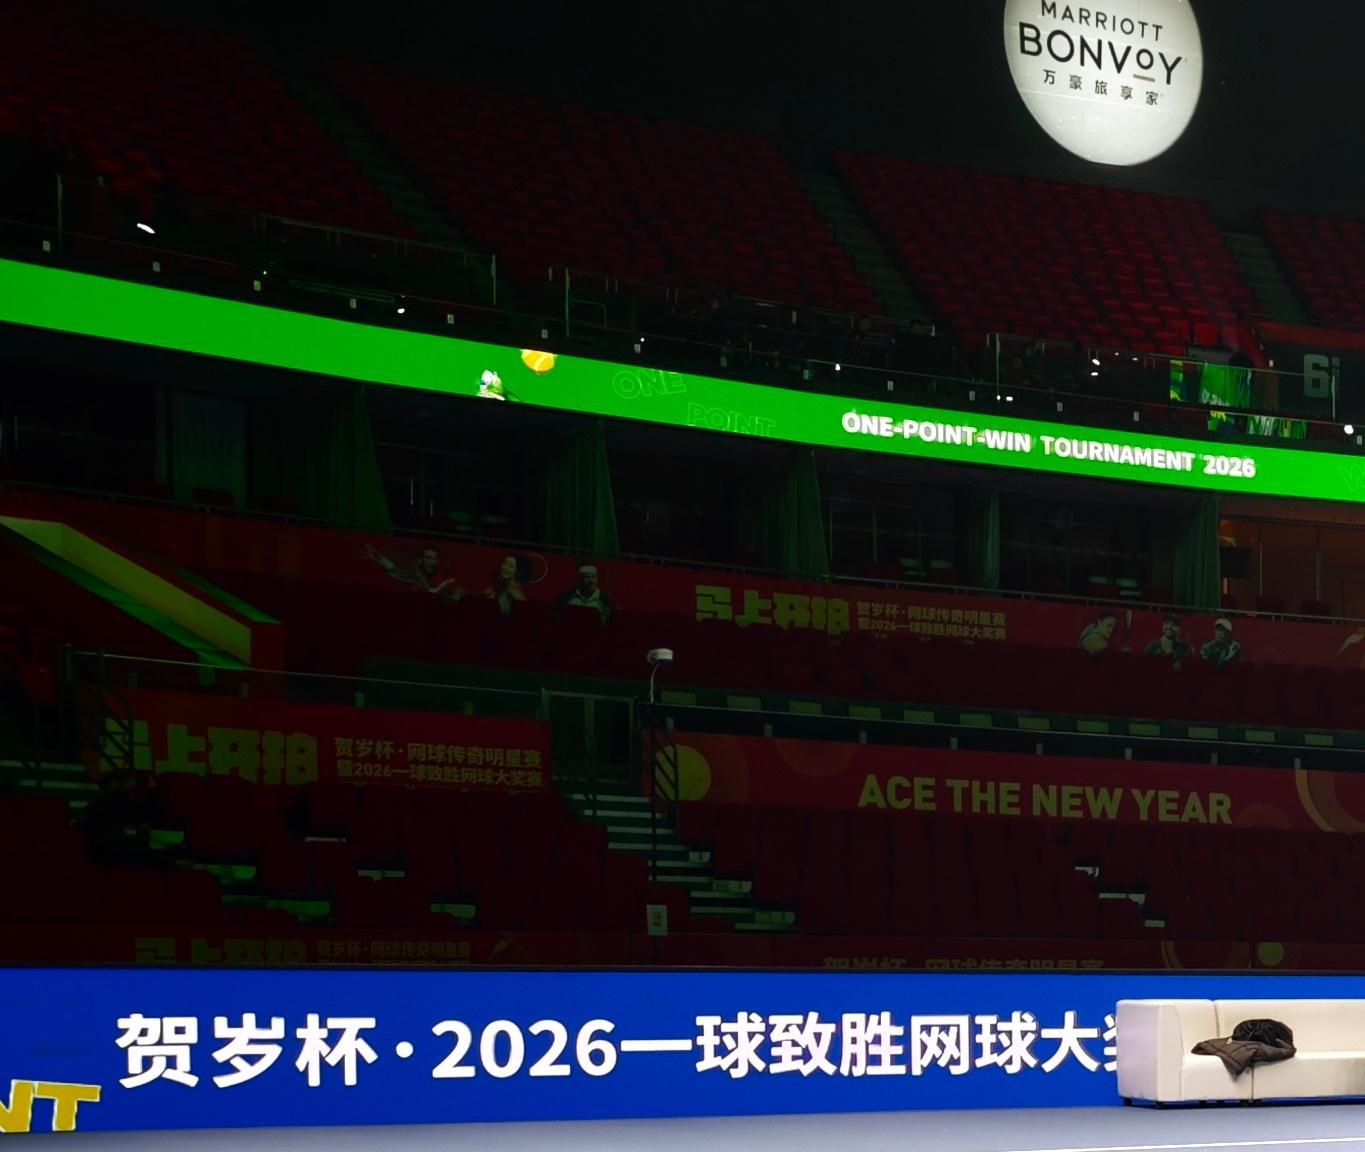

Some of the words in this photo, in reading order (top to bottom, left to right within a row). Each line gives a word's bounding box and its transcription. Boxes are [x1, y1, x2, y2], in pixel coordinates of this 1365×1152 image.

[1041, 0, 1163, 42] MARRIOTT
[1019, 22, 1183, 85] BONVOY
[1043, 69, 1158, 106] 万豪旅享家
[842, 411, 1031, 453] ONE-POINT-WIN
[1040, 435, 1195, 472] TOURNAMENT
[1203, 454, 1256, 479] 2026
[858, 774, 936, 811] ACE
[946, 779, 1023, 815] THE
[1032, 784, 1121, 821] NEW
[1130, 788, 1232, 824] YEAR
